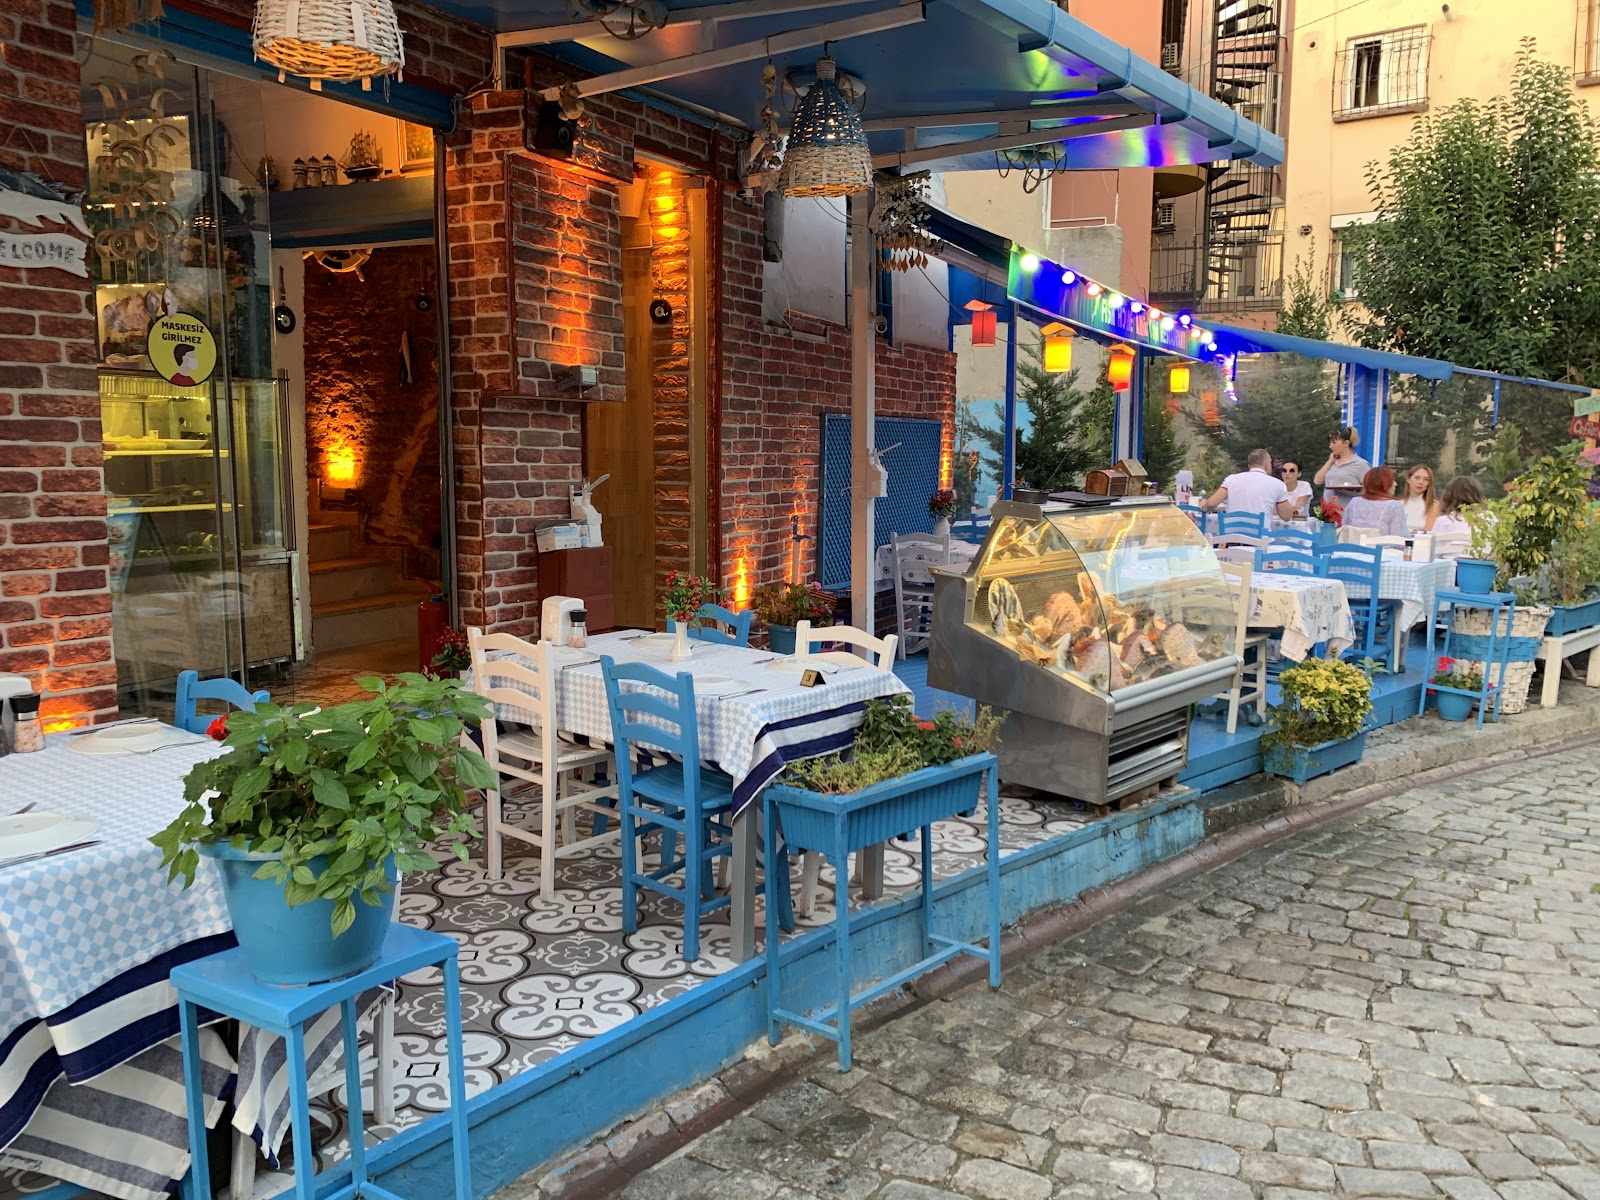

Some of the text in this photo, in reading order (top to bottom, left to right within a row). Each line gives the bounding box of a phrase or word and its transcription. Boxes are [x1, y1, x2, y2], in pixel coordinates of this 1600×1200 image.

[0, 239, 76, 264] ELCOME
[161, 321, 205, 334] MASKESİZ
[161, 331, 202, 345] GİRİLMEZ
[805, 674, 812, 682] 3
